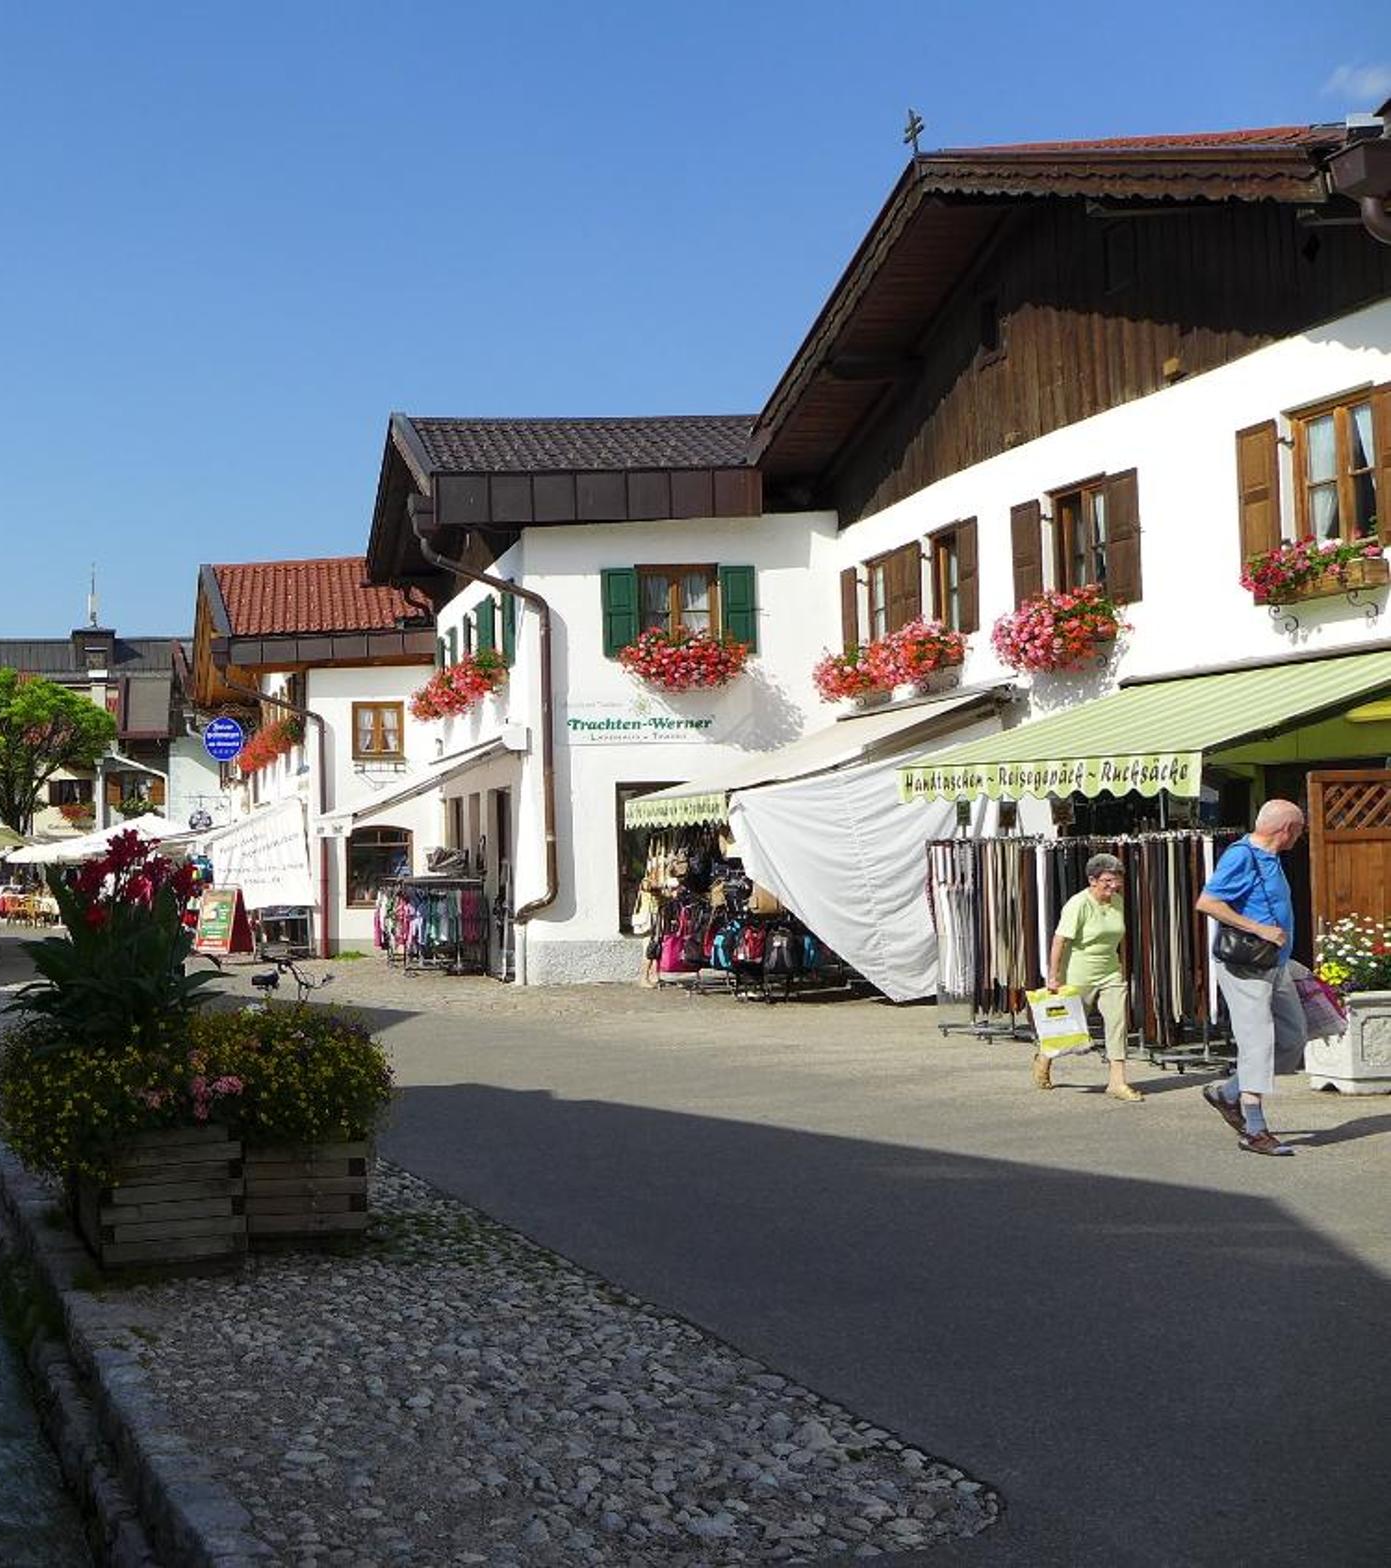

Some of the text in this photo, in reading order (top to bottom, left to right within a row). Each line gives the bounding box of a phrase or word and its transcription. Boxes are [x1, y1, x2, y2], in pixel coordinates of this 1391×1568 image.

[566, 716, 713, 731] Trachten-Werner
[905, 757, 1190, 792] Handtaschen Reisegepäck Rucksäcke
